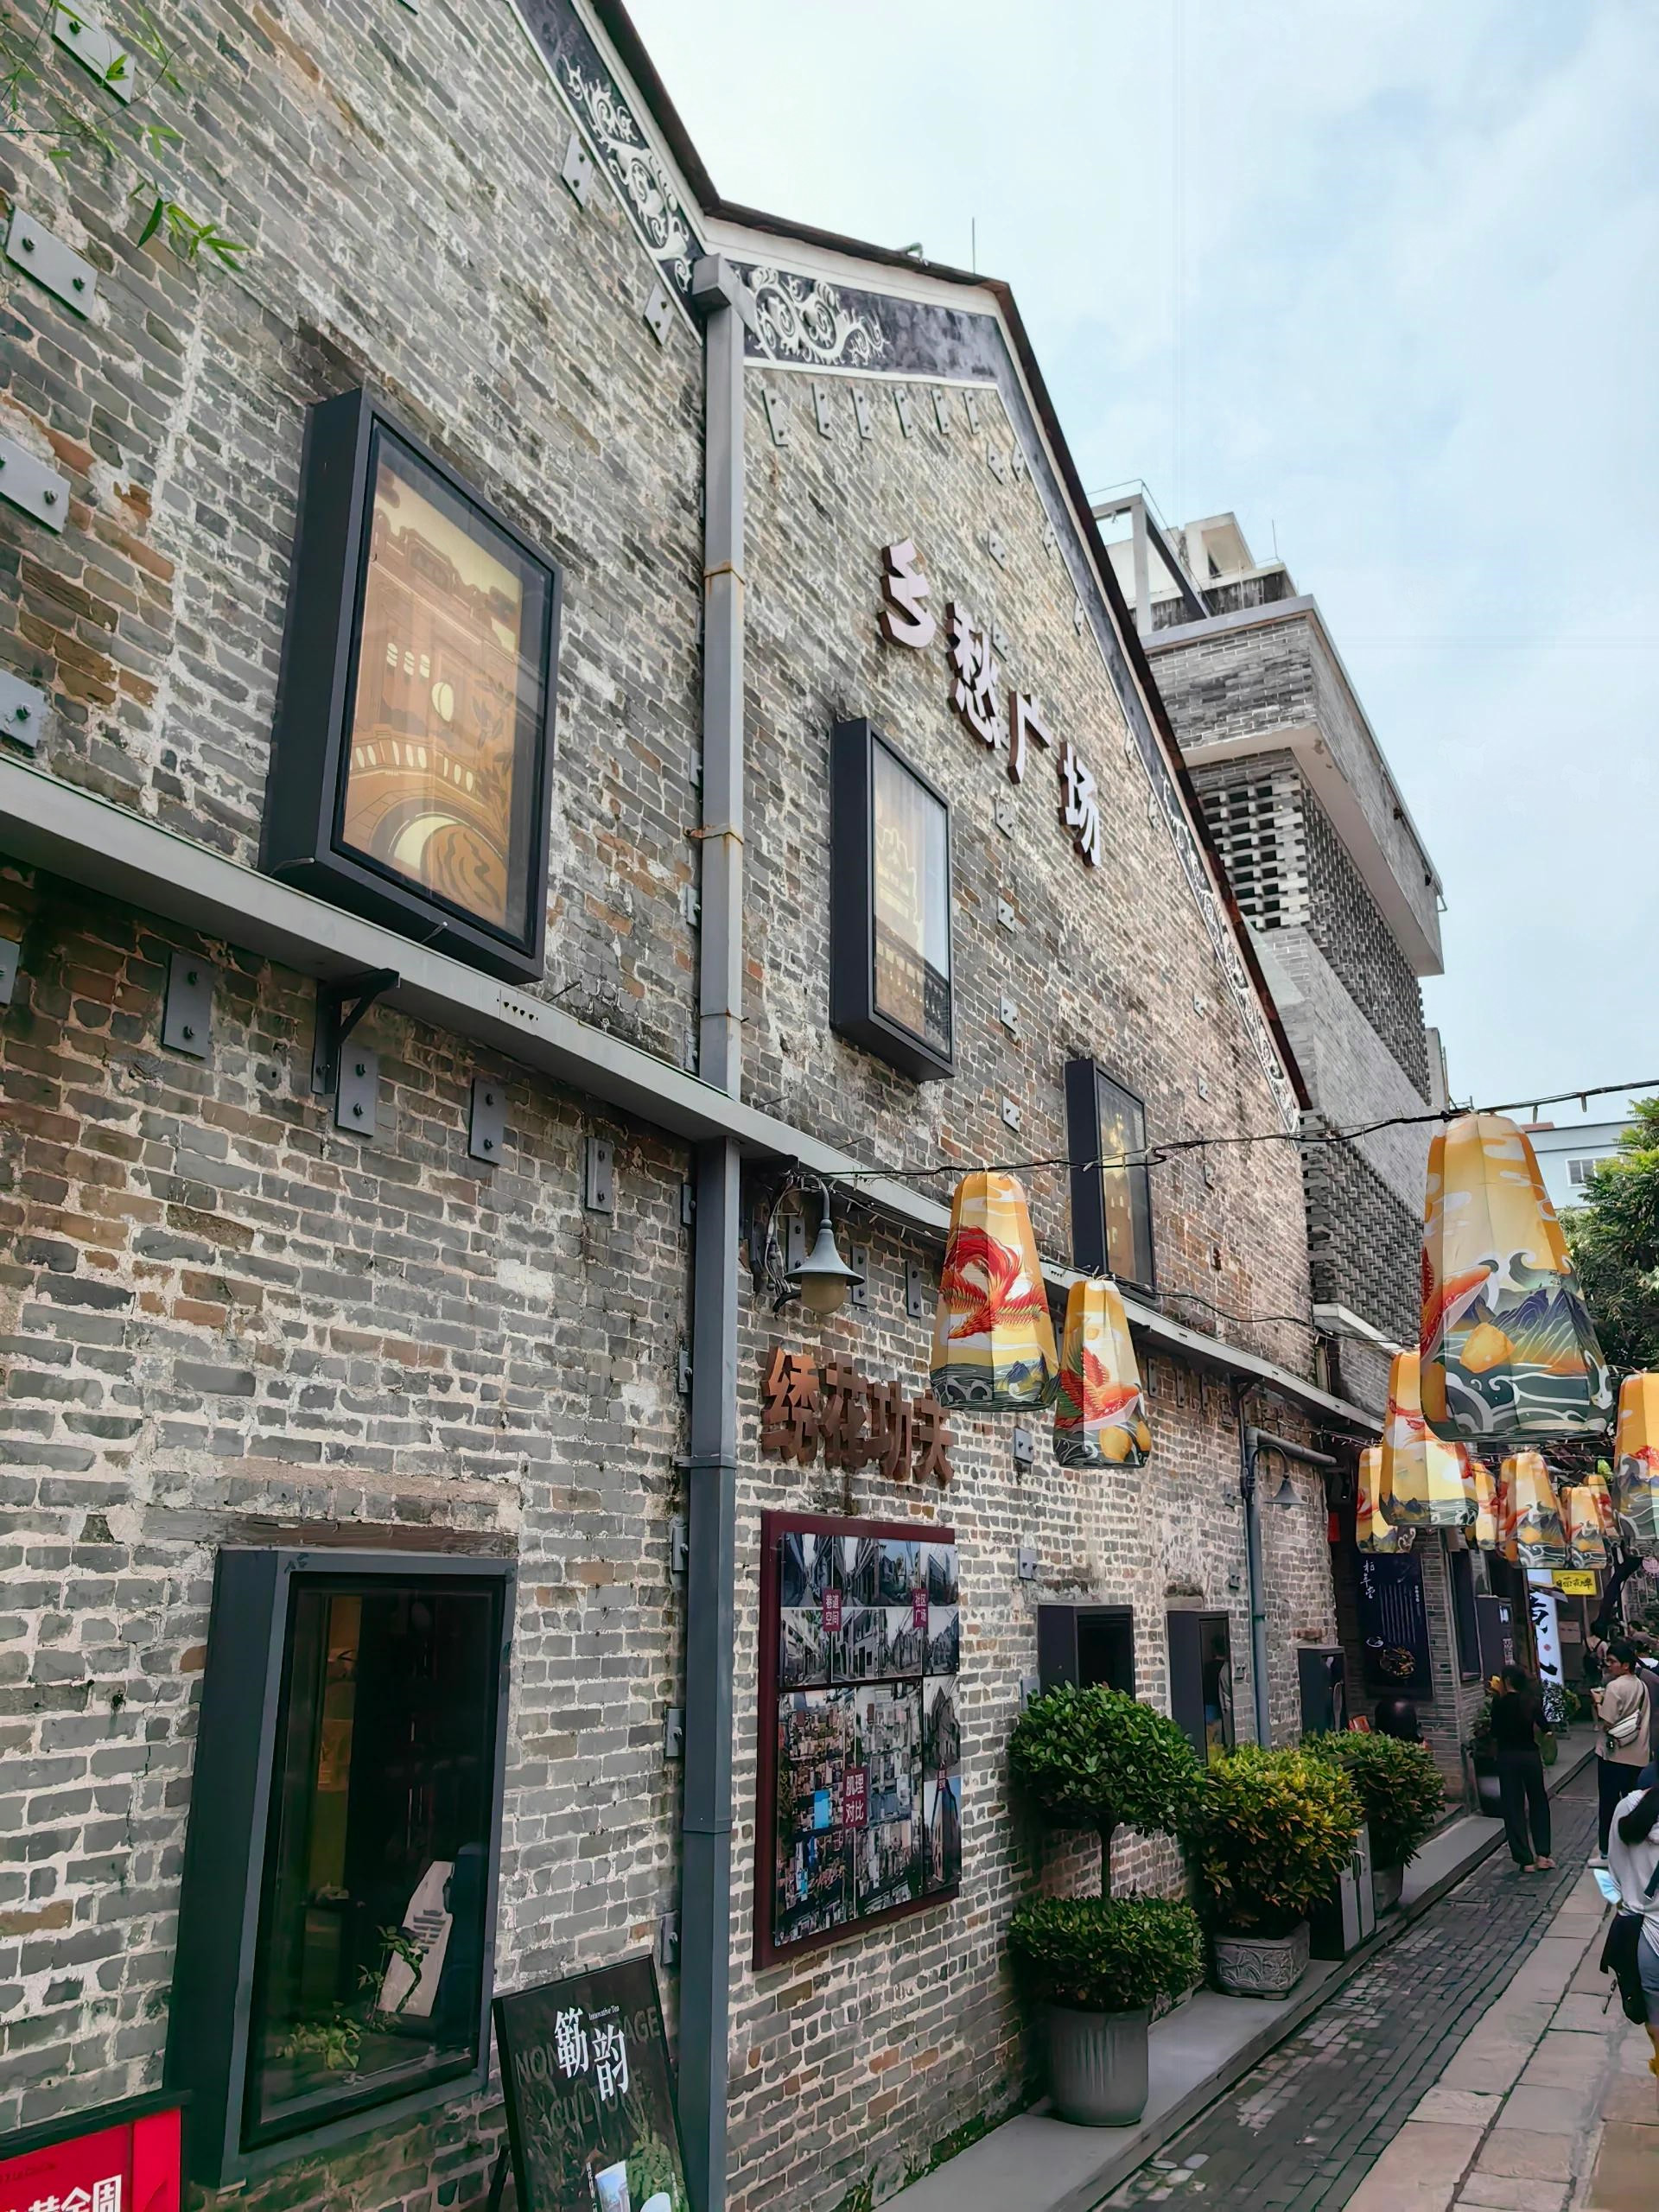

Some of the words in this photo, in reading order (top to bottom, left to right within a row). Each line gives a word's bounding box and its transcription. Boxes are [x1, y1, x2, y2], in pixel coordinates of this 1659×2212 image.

[879, 537, 1101, 868] 乡愁广场
[760, 1345, 955, 1488] 绣花功夫
